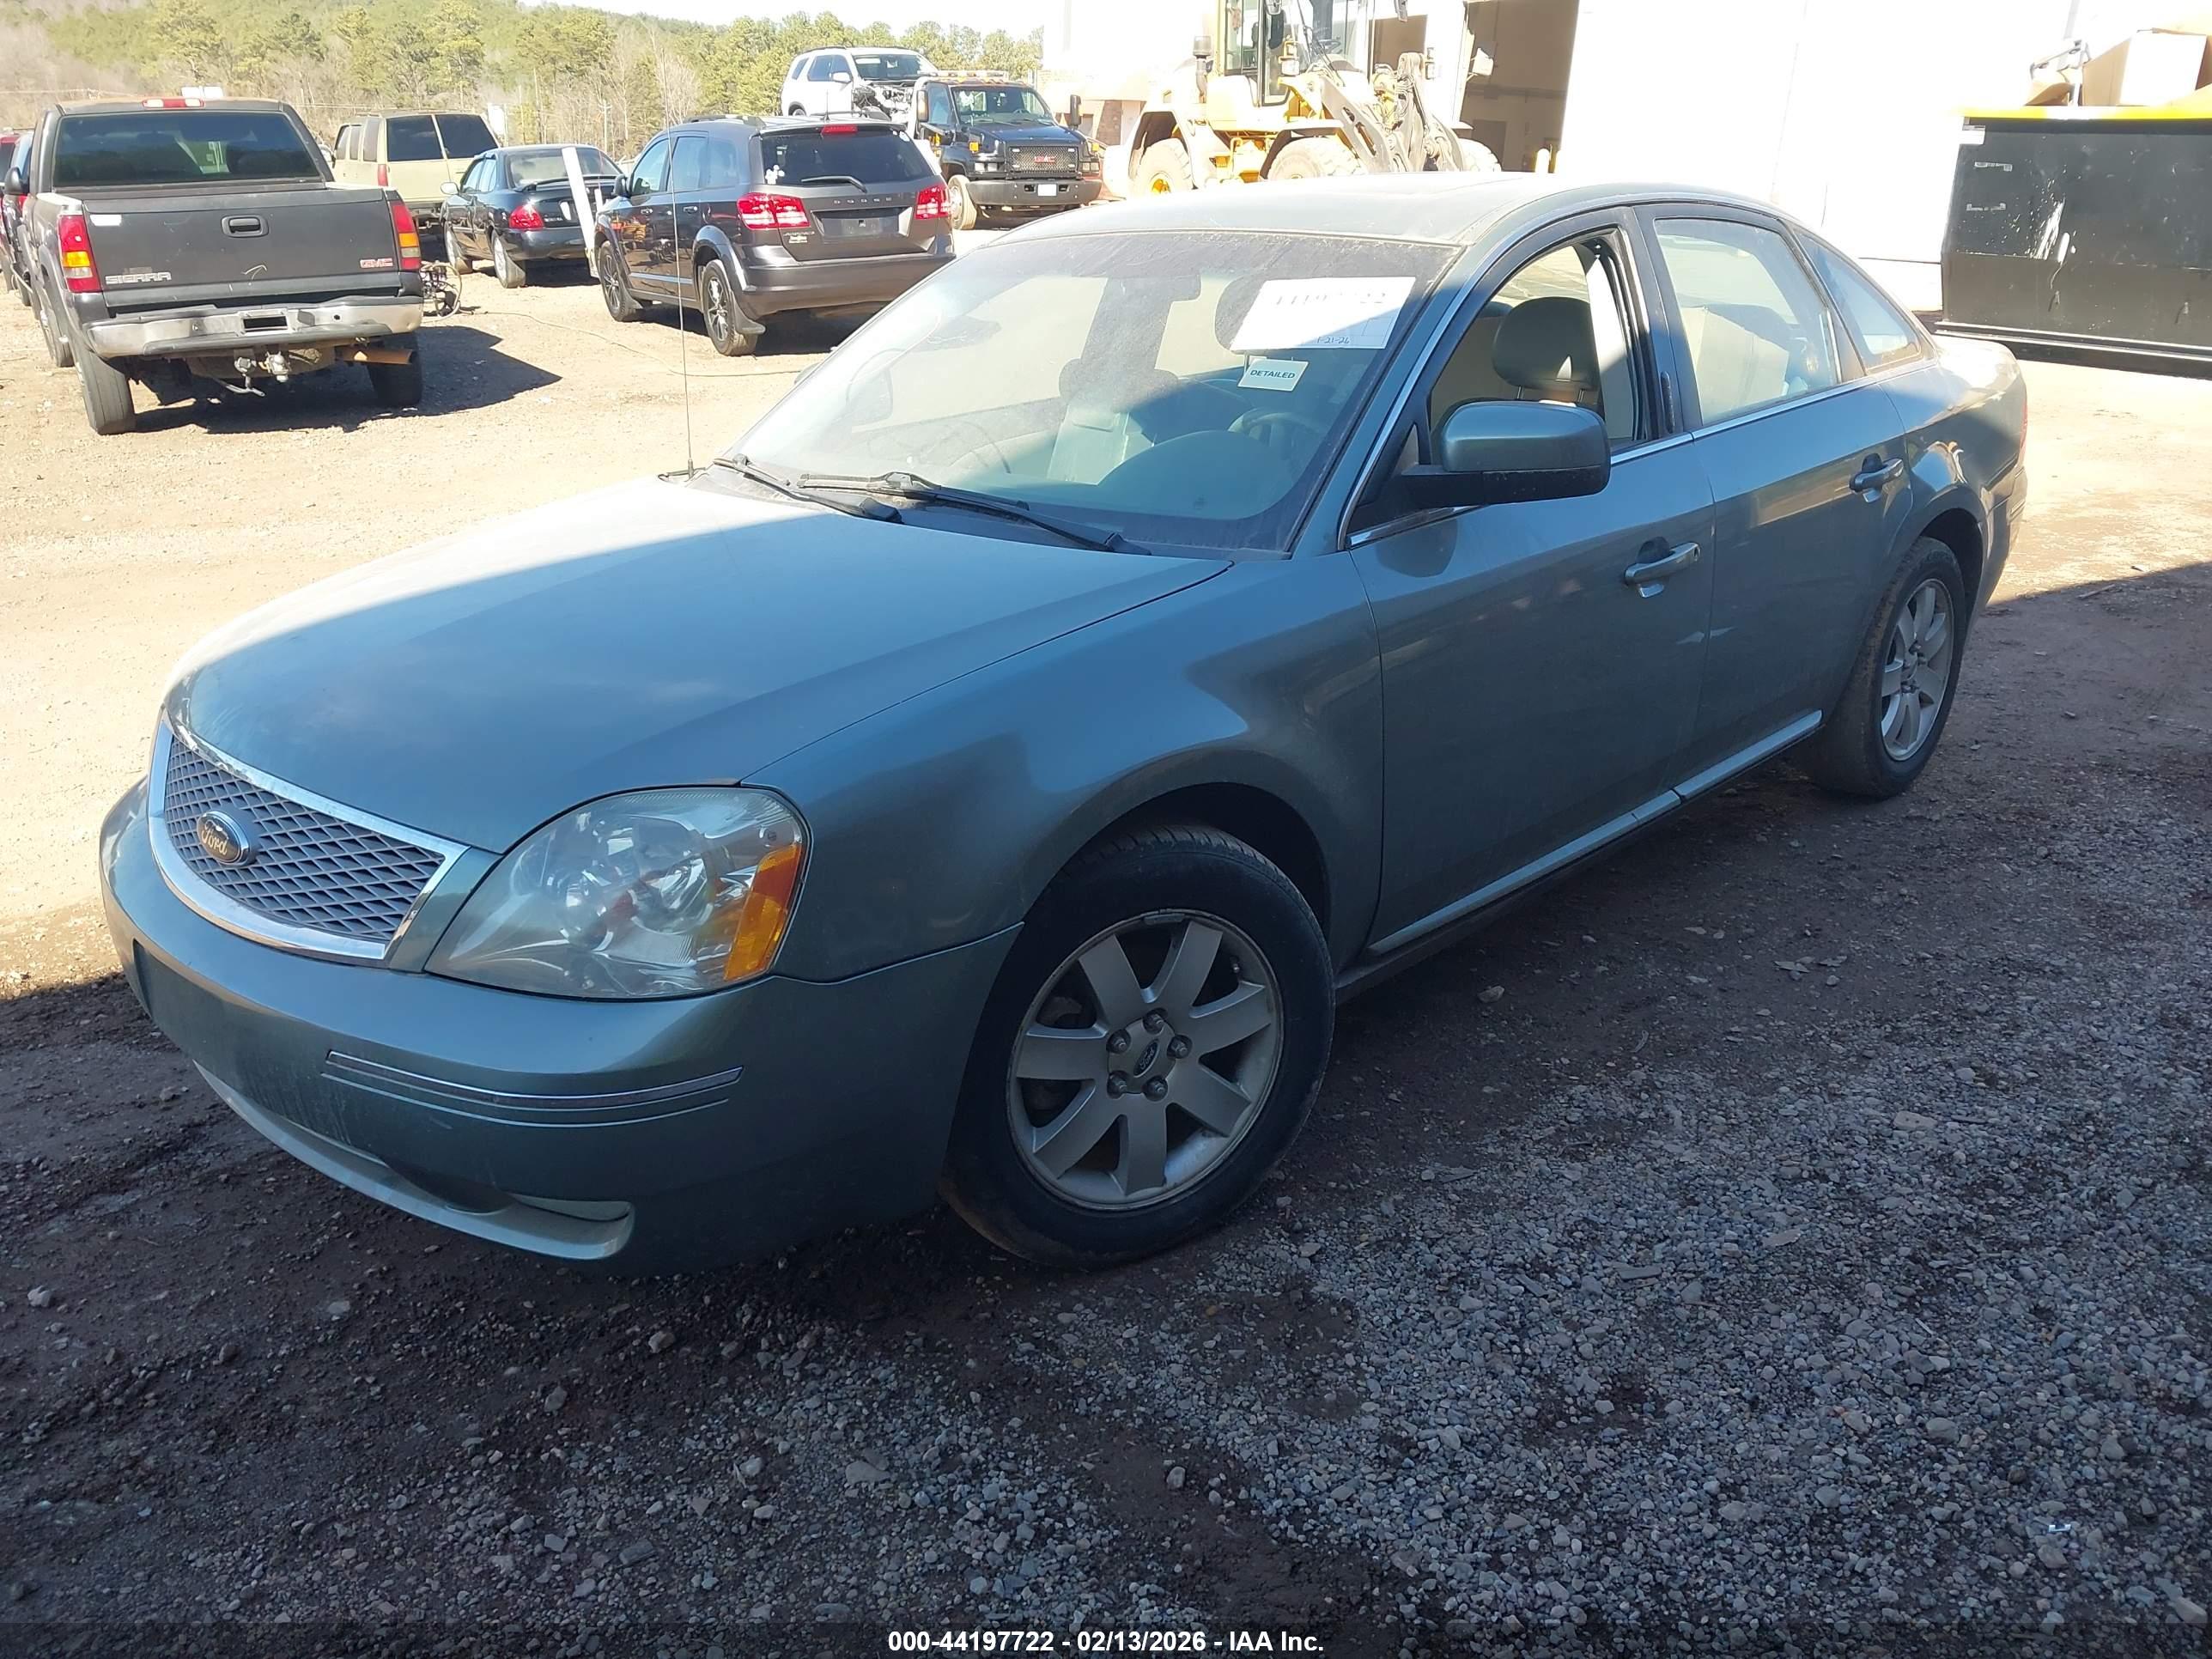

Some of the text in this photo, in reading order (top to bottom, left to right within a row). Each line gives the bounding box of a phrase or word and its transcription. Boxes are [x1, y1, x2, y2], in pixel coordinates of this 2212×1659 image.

[359, 258, 393, 269] GMC
[105, 271, 172, 285] SIERRA
[1249, 369, 1296, 379] DETAILED
[201, 819, 229, 855] Ford
